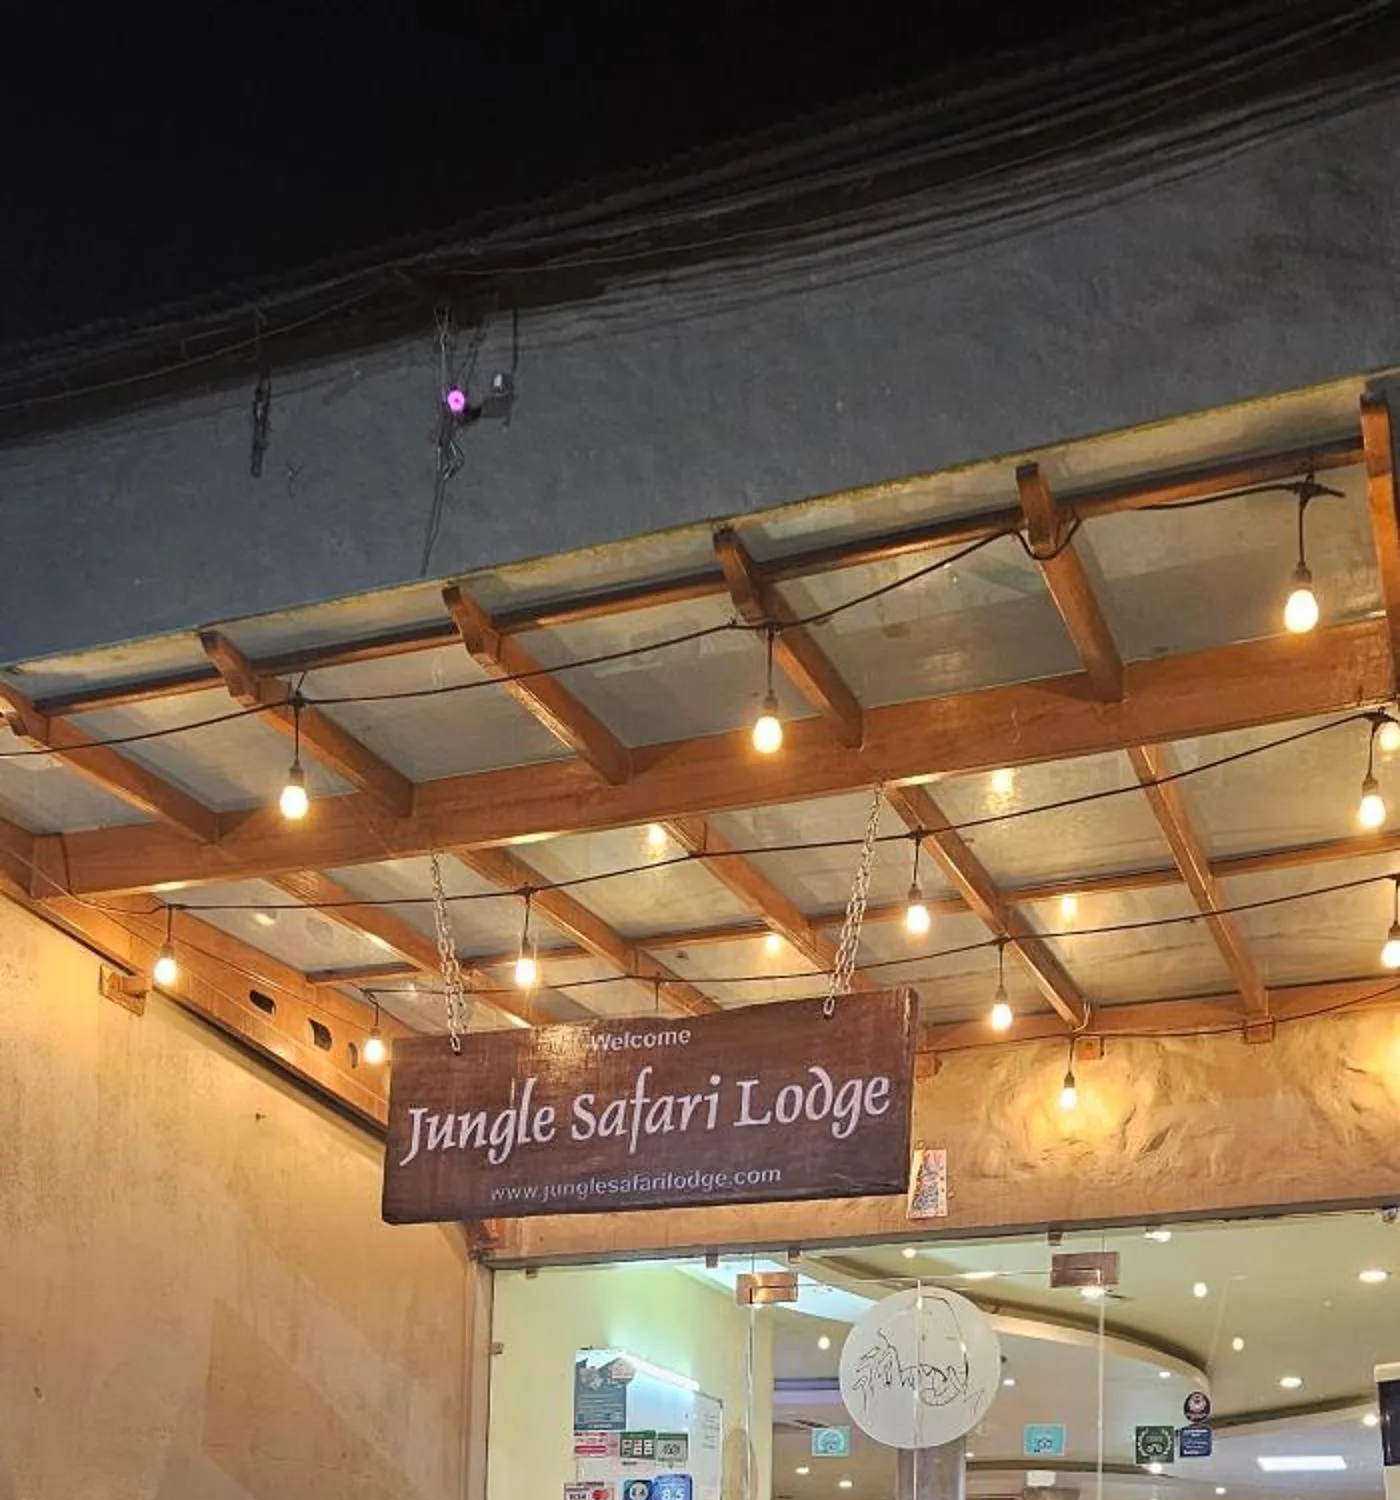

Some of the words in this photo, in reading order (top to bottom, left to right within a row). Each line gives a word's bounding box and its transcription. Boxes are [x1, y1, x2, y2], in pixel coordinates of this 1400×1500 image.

[591, 1028, 692, 1051] Welcome
[400, 1077, 556, 1166] Jungle
[571, 1065, 721, 1154] Safari
[733, 1066, 891, 1140] Lodge
[491, 1168, 781, 1201] www.junglesafarilodge.com
